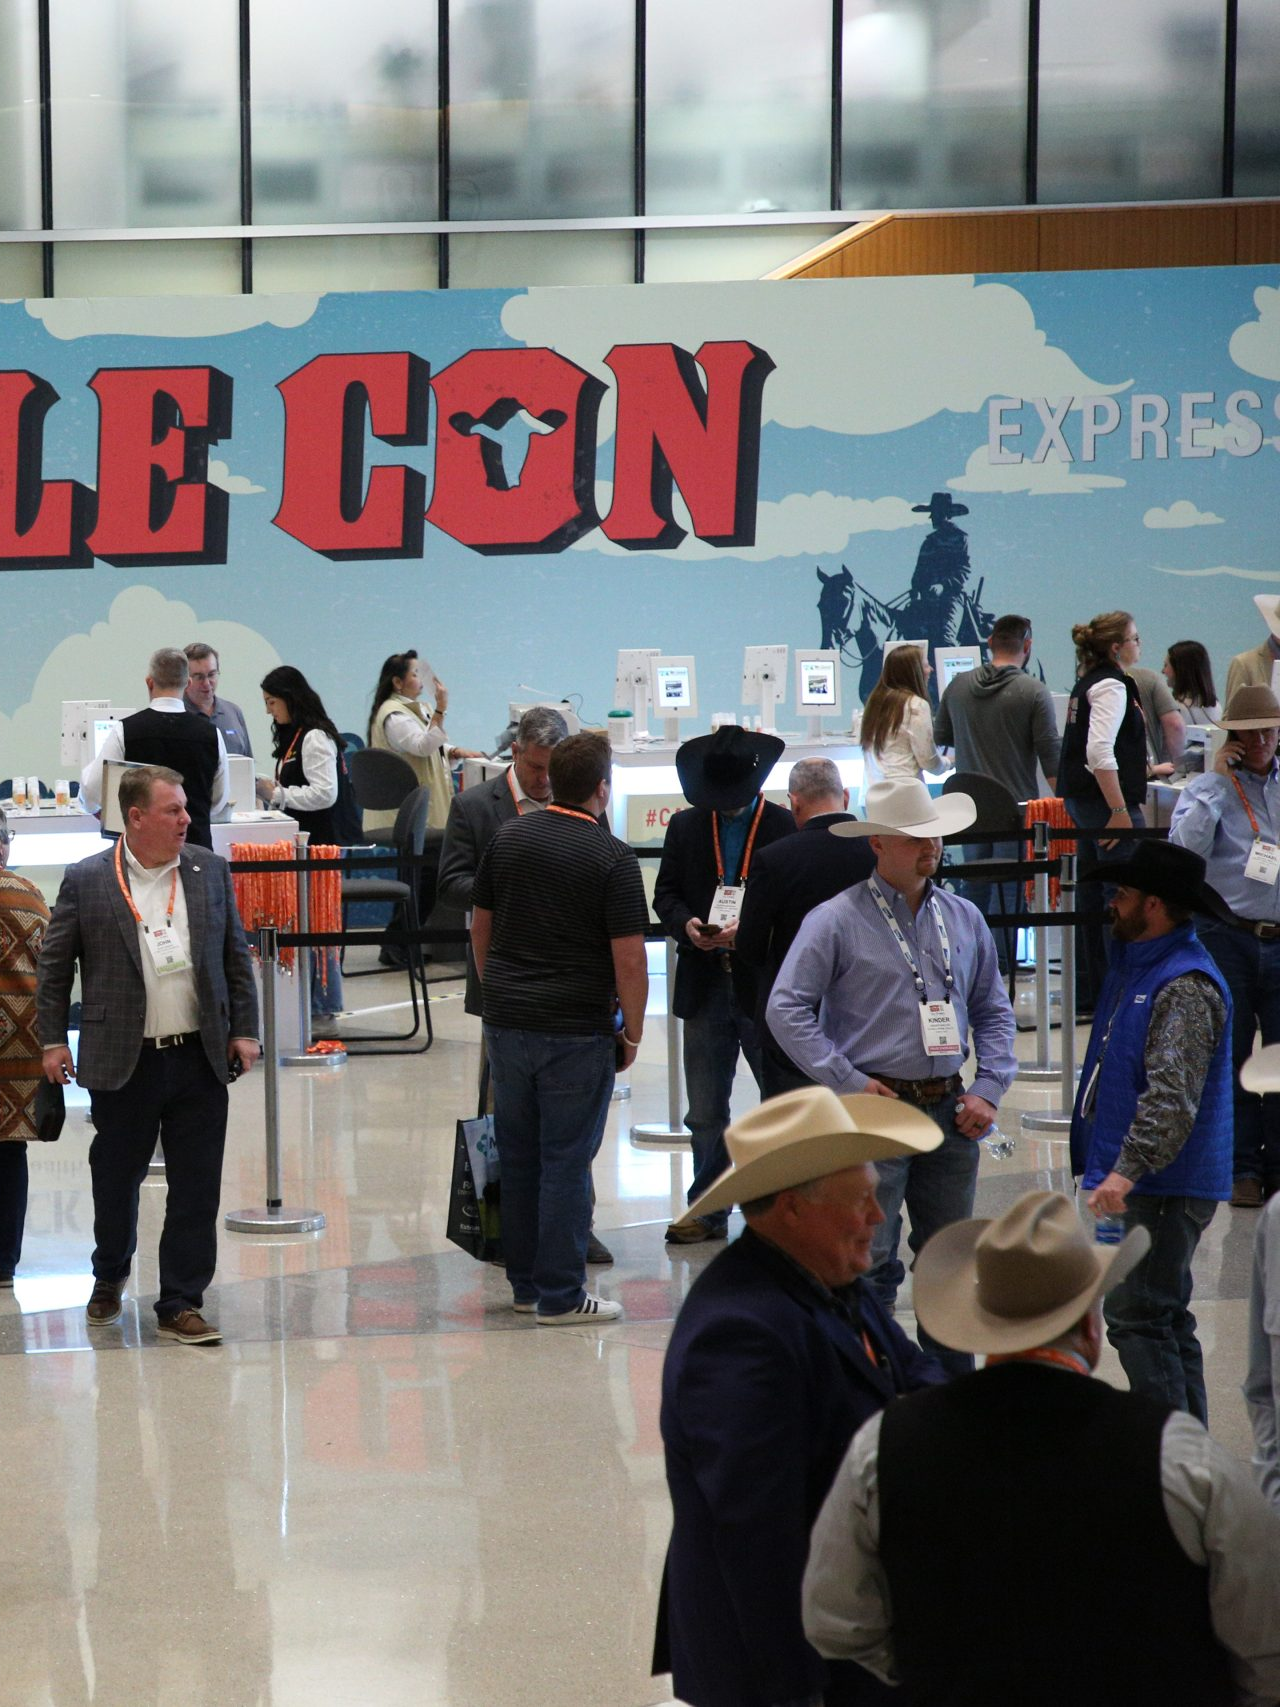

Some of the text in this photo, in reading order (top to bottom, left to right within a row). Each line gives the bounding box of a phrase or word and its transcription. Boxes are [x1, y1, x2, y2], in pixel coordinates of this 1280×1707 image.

[270, 340, 778, 562] CON
[988, 388, 1280, 466] EXPRES
[928, 1016, 951, 1024] KINDER
